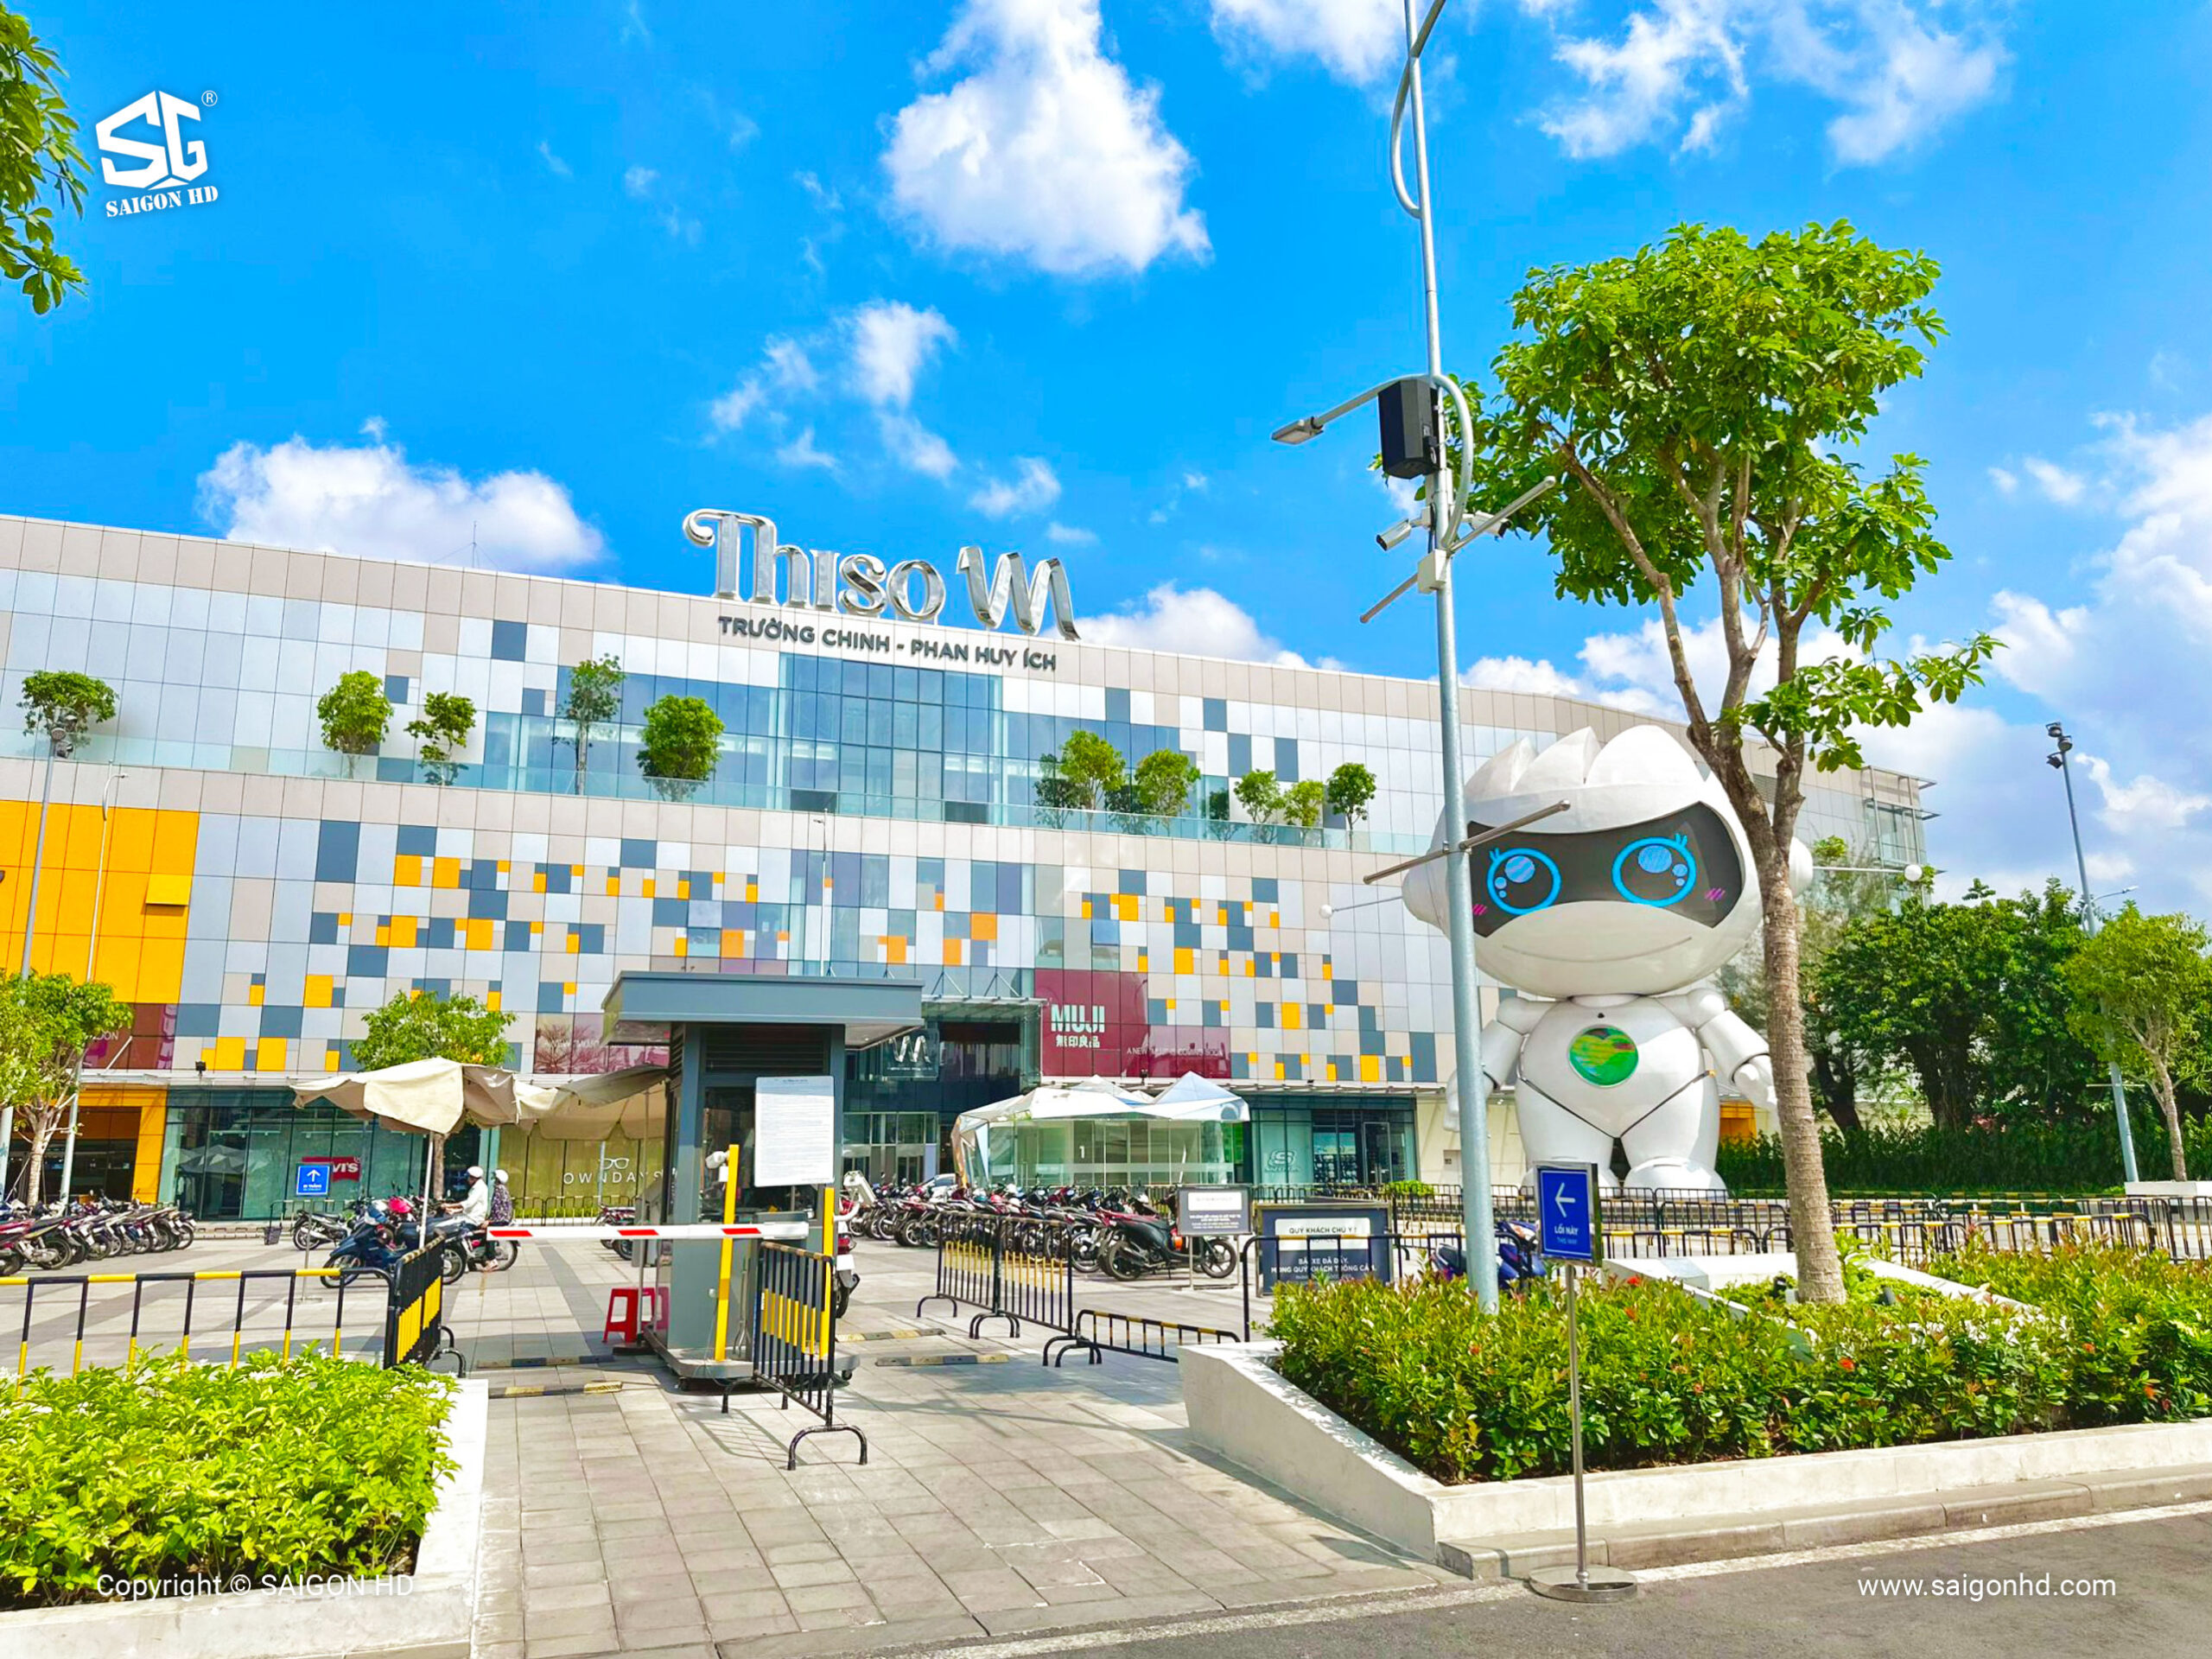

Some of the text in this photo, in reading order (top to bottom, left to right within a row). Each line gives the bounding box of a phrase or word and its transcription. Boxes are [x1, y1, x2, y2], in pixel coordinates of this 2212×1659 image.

[718, 614, 816, 645] TRƯỜNG
[817, 628, 890, 652] CHINH
[911, 638, 969, 661] PHAN
[975, 645, 1017, 666] HUY
[1023, 646, 1057, 671] ÍCH
[1051, 1004, 1105, 1033] MUJI
